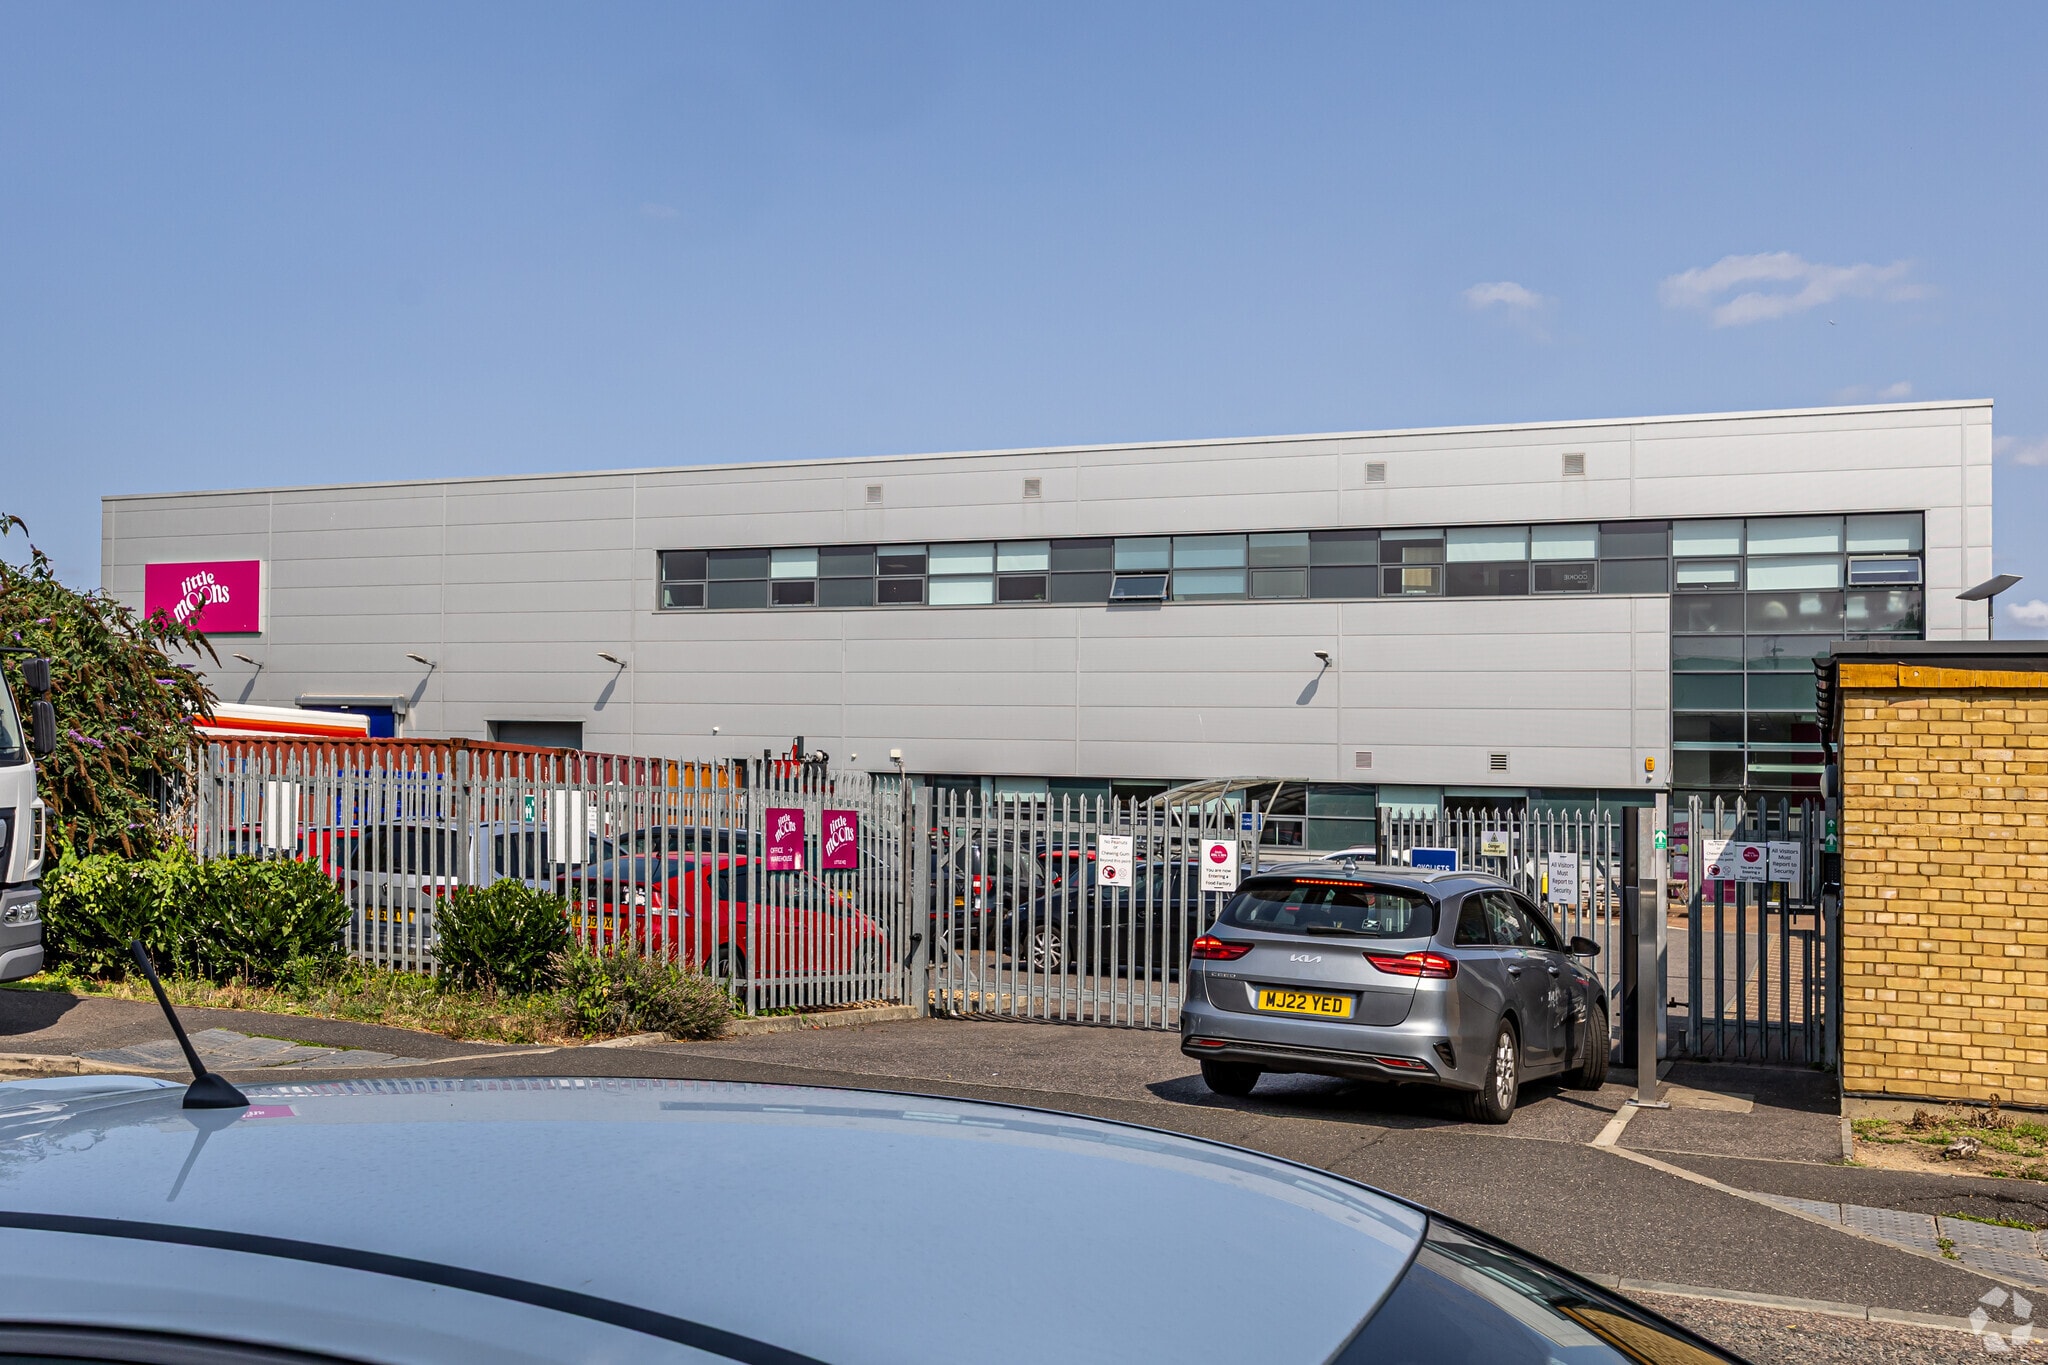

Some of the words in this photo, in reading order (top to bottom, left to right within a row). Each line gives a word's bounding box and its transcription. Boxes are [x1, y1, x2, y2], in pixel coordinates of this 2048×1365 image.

[181, 571, 214, 596] little
[174, 584, 230, 622] moons
[778, 814, 791, 827] little
[830, 815, 847, 835] little
[775, 821, 796, 843] moons
[825, 827, 854, 857] moons
[1553, 887, 1572, 895] Security
[1290, 953, 1322, 963] KIA
[1266, 991, 1306, 1010] MJ22
[1312, 997, 1342, 1013] YED
